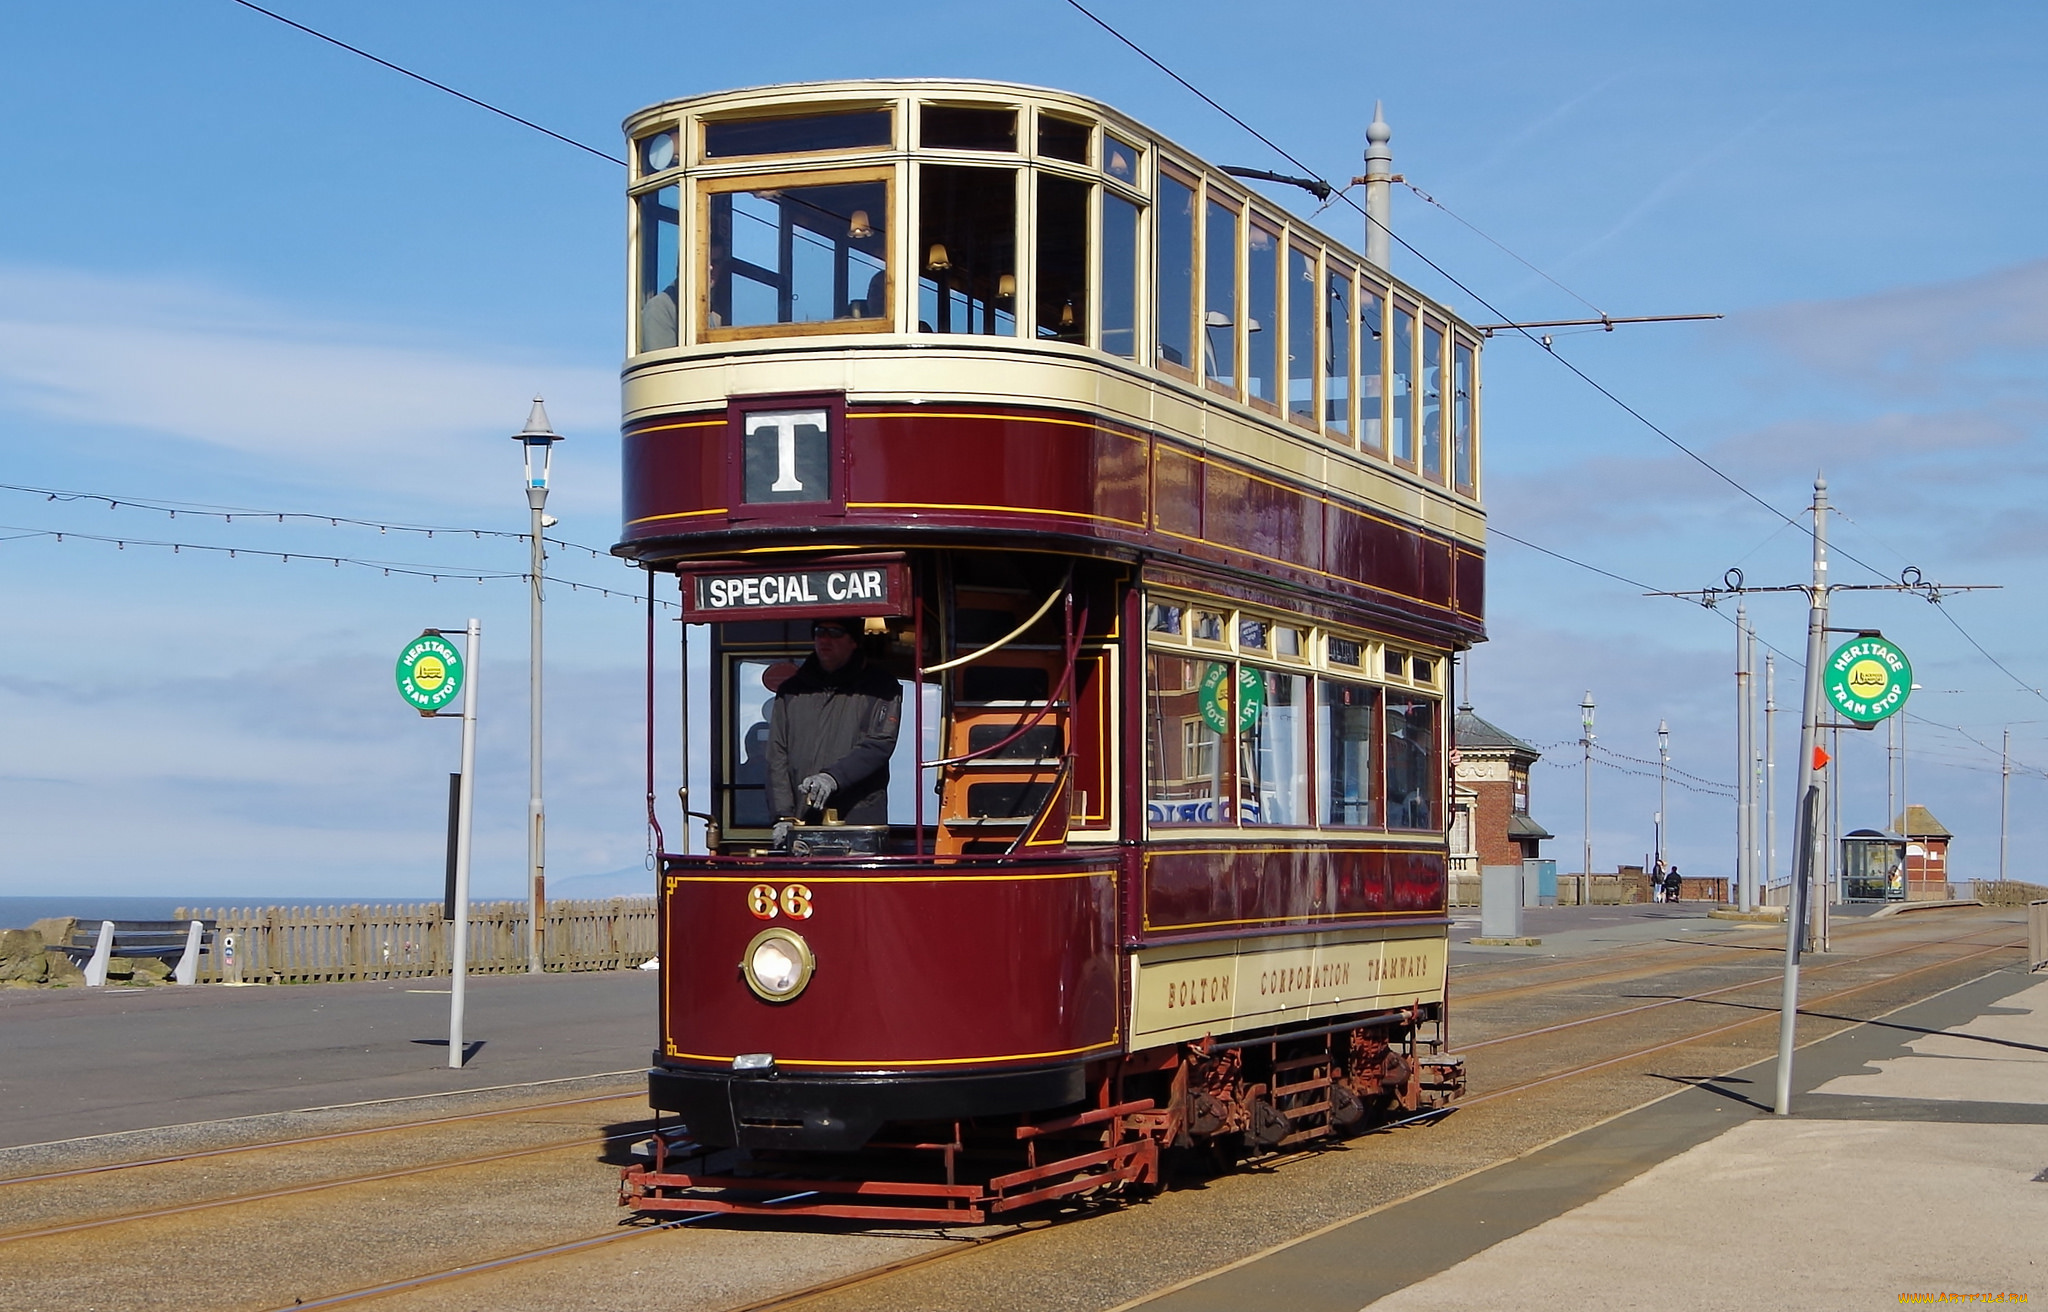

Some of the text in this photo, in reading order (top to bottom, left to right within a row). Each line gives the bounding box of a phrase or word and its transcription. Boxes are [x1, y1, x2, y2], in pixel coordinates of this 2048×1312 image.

[745, 413, 827, 492] T
[709, 570, 882, 607] SPECIAL CAR
[403, 641, 457, 666] HERITAGE
[1834, 643, 1903, 672] HERITAGE
[402, 676, 456, 704] TRAM STOP
[1832, 682, 1902, 715] TRAM STOP
[747, 883, 814, 921] 66
[1168, 954, 1428, 1009] BOLTON CORPORATION TRAMWAYS
